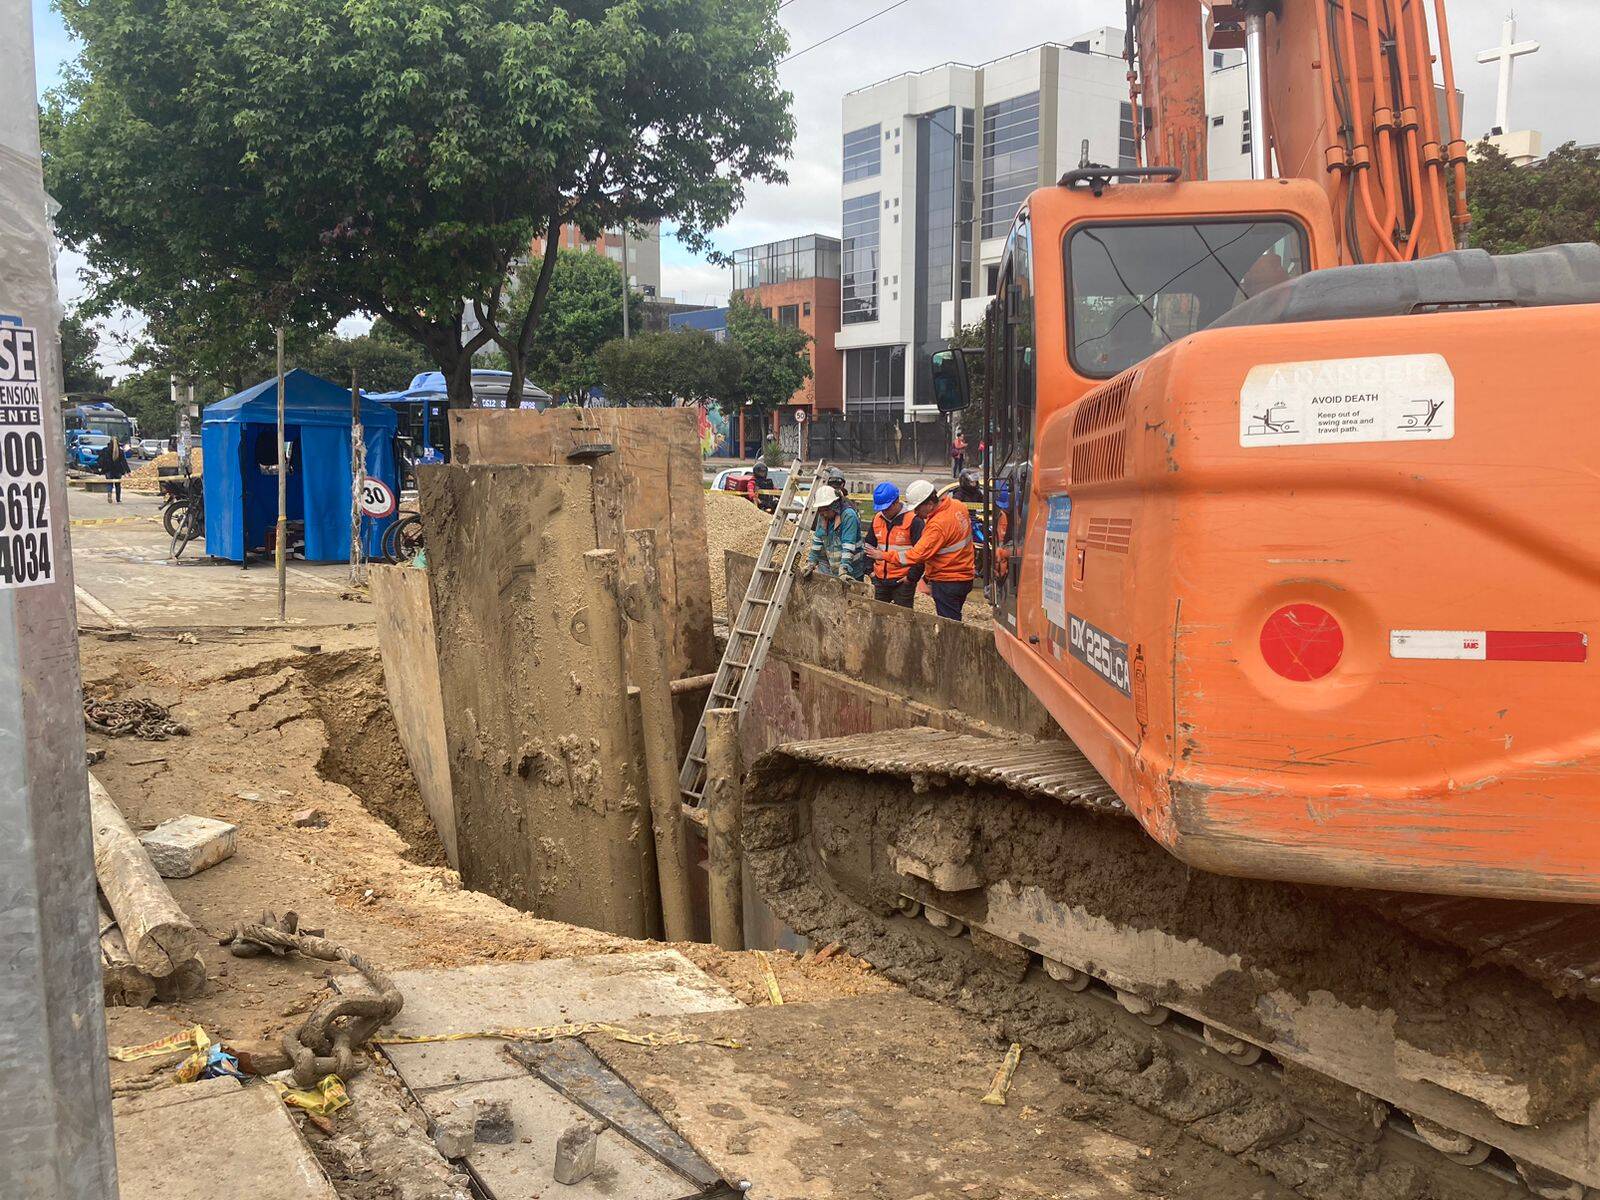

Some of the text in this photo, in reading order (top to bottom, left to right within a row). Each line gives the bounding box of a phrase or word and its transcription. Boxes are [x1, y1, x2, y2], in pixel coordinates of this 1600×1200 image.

[1311, 394, 1379, 404] AVOID DEATH
[0, 409, 38, 422] ENTE
[1340, 426, 1359, 434] path.
[0, 431, 44, 477] 00
[363, 487, 385, 504] 30
